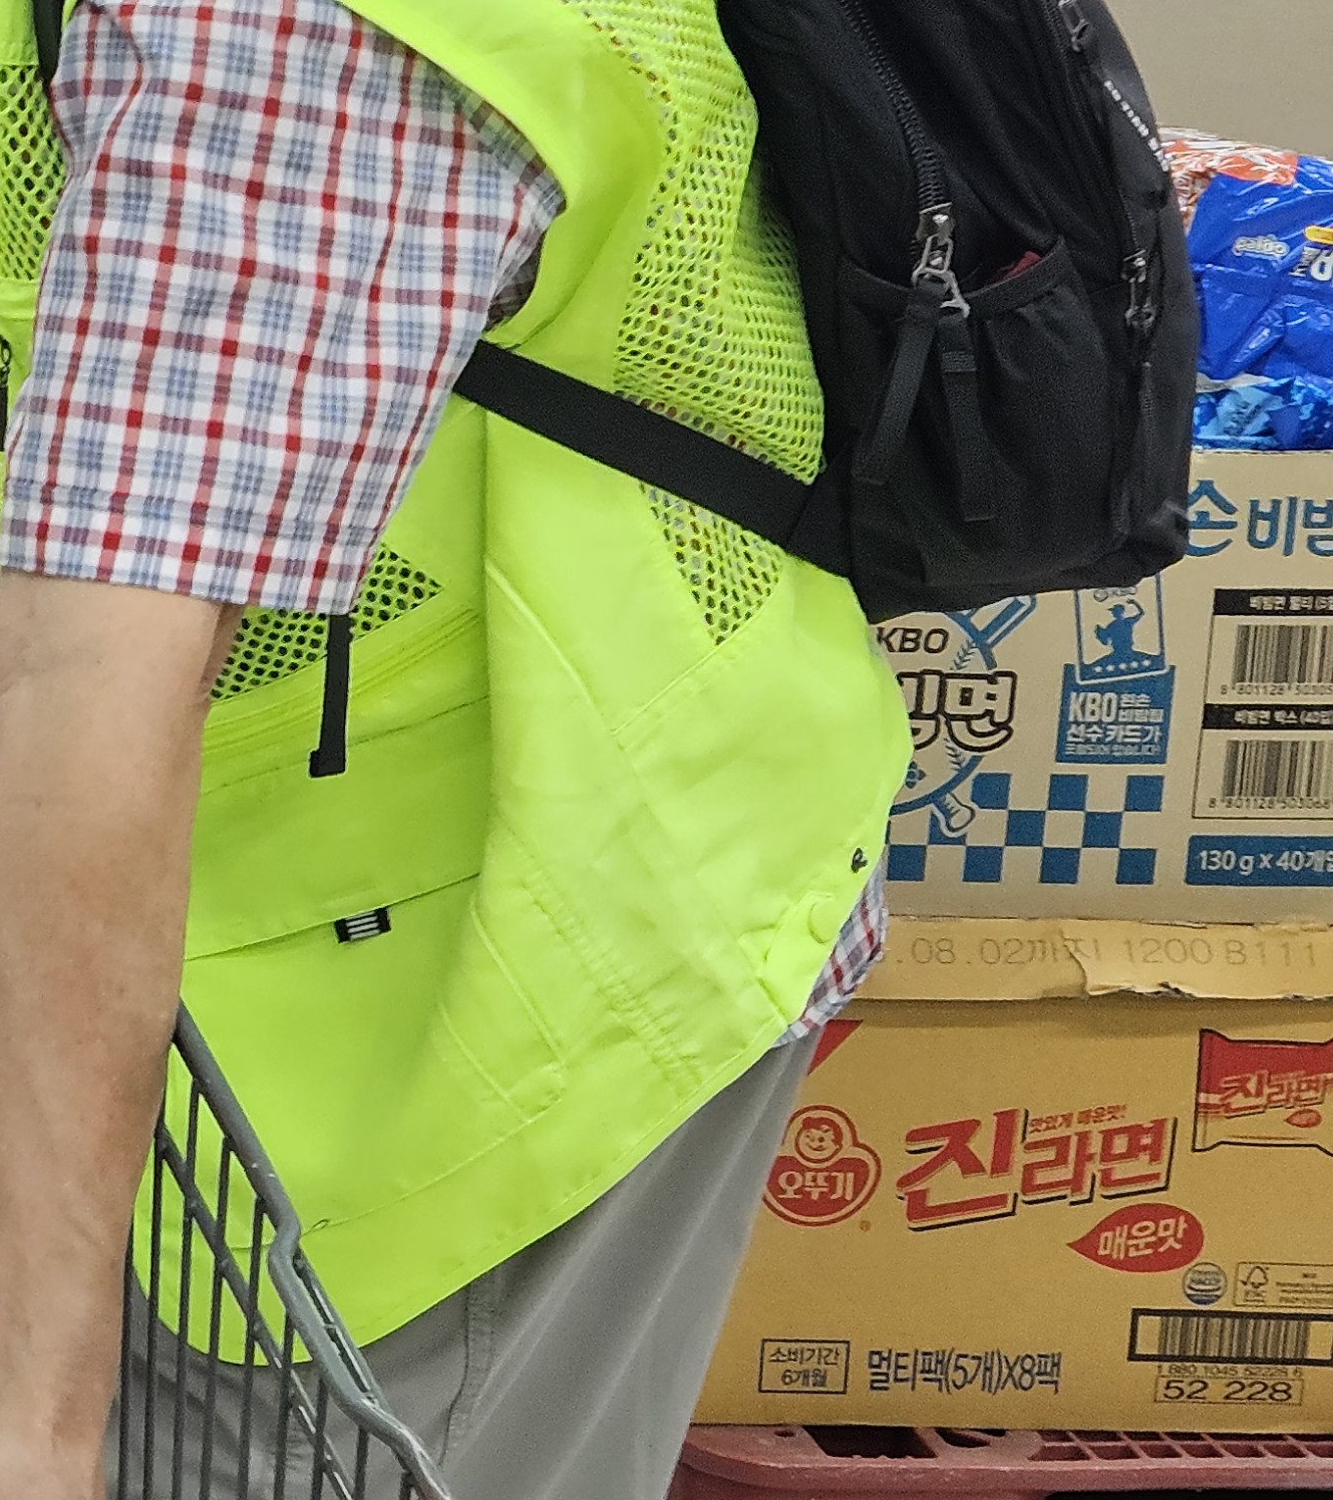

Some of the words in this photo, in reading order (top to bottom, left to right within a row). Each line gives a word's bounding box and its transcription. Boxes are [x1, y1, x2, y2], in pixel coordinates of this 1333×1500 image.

[877, 627, 950, 654] KBO
[1068, 692, 1118, 723] KBO
[1066, 724, 1104, 743] 선수
[1105, 724, 1163, 744] 카드가
[1199, 849, 1236, 871] 130
[895, 1107, 1179, 1231] 진라면
[778, 1171, 855, 1201] 오뚜기
[1097, 1215, 1189, 1261] 매운맛
[768, 1346, 840, 1369] 소비기간
[780, 1367, 828, 1389] 6개월
[1162, 1379, 1208, 1401] 52
[1224, 1379, 1293, 1402] 228
